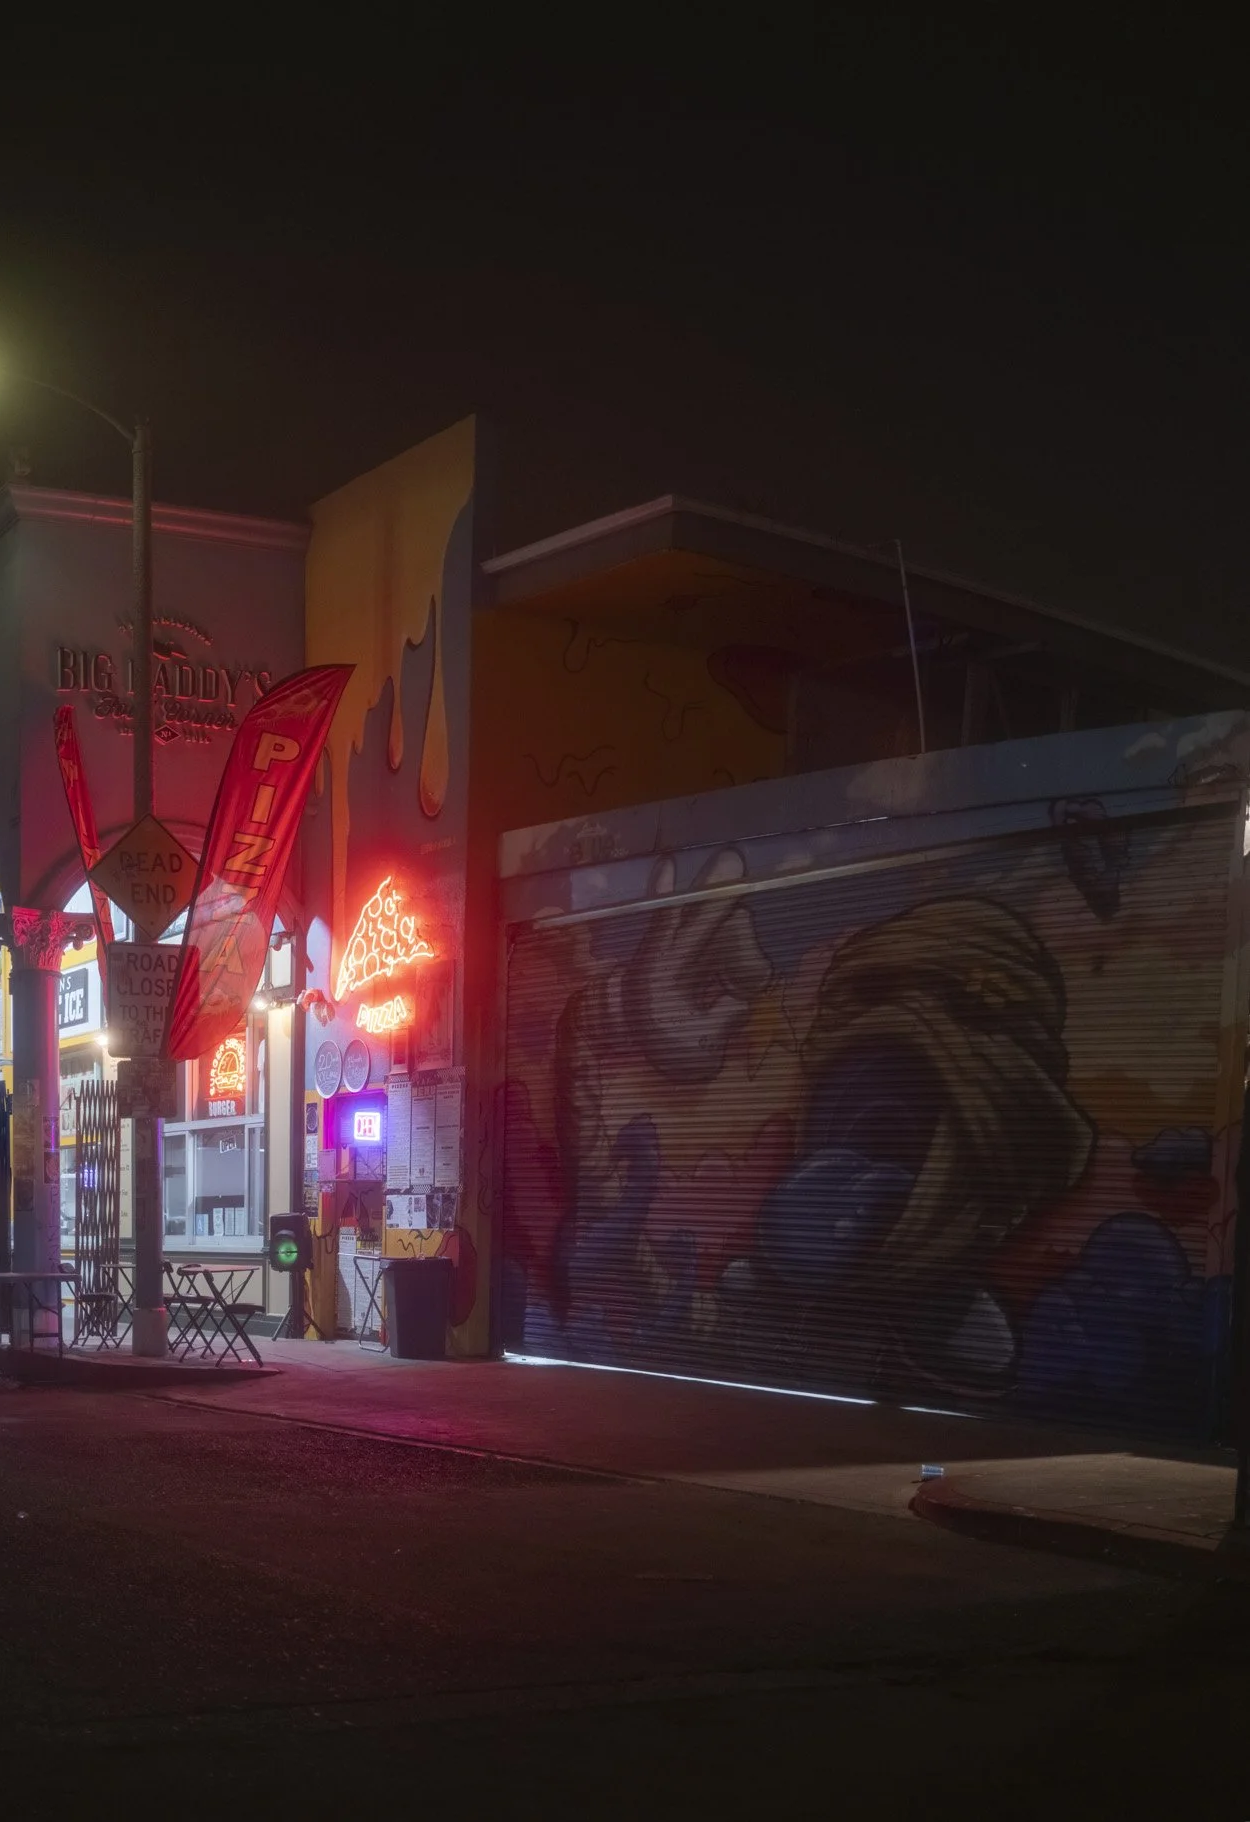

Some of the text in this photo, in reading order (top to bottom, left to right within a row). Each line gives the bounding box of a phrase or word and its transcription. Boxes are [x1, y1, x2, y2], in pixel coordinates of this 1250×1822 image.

[55, 647, 116, 693] BIG
[119, 852, 183, 874] DEAD
[131, 883, 176, 905] END
[126, 952, 179, 973] ROAD
[59, 976, 72, 993] NS
[116, 979, 176, 997] CLOSE
[119, 1003, 140, 1022] TO
[356, 995, 407, 1033] PIZZA
[120, 1027, 163, 1045] TRAF
[208, 1099, 238, 1117] BURGER
